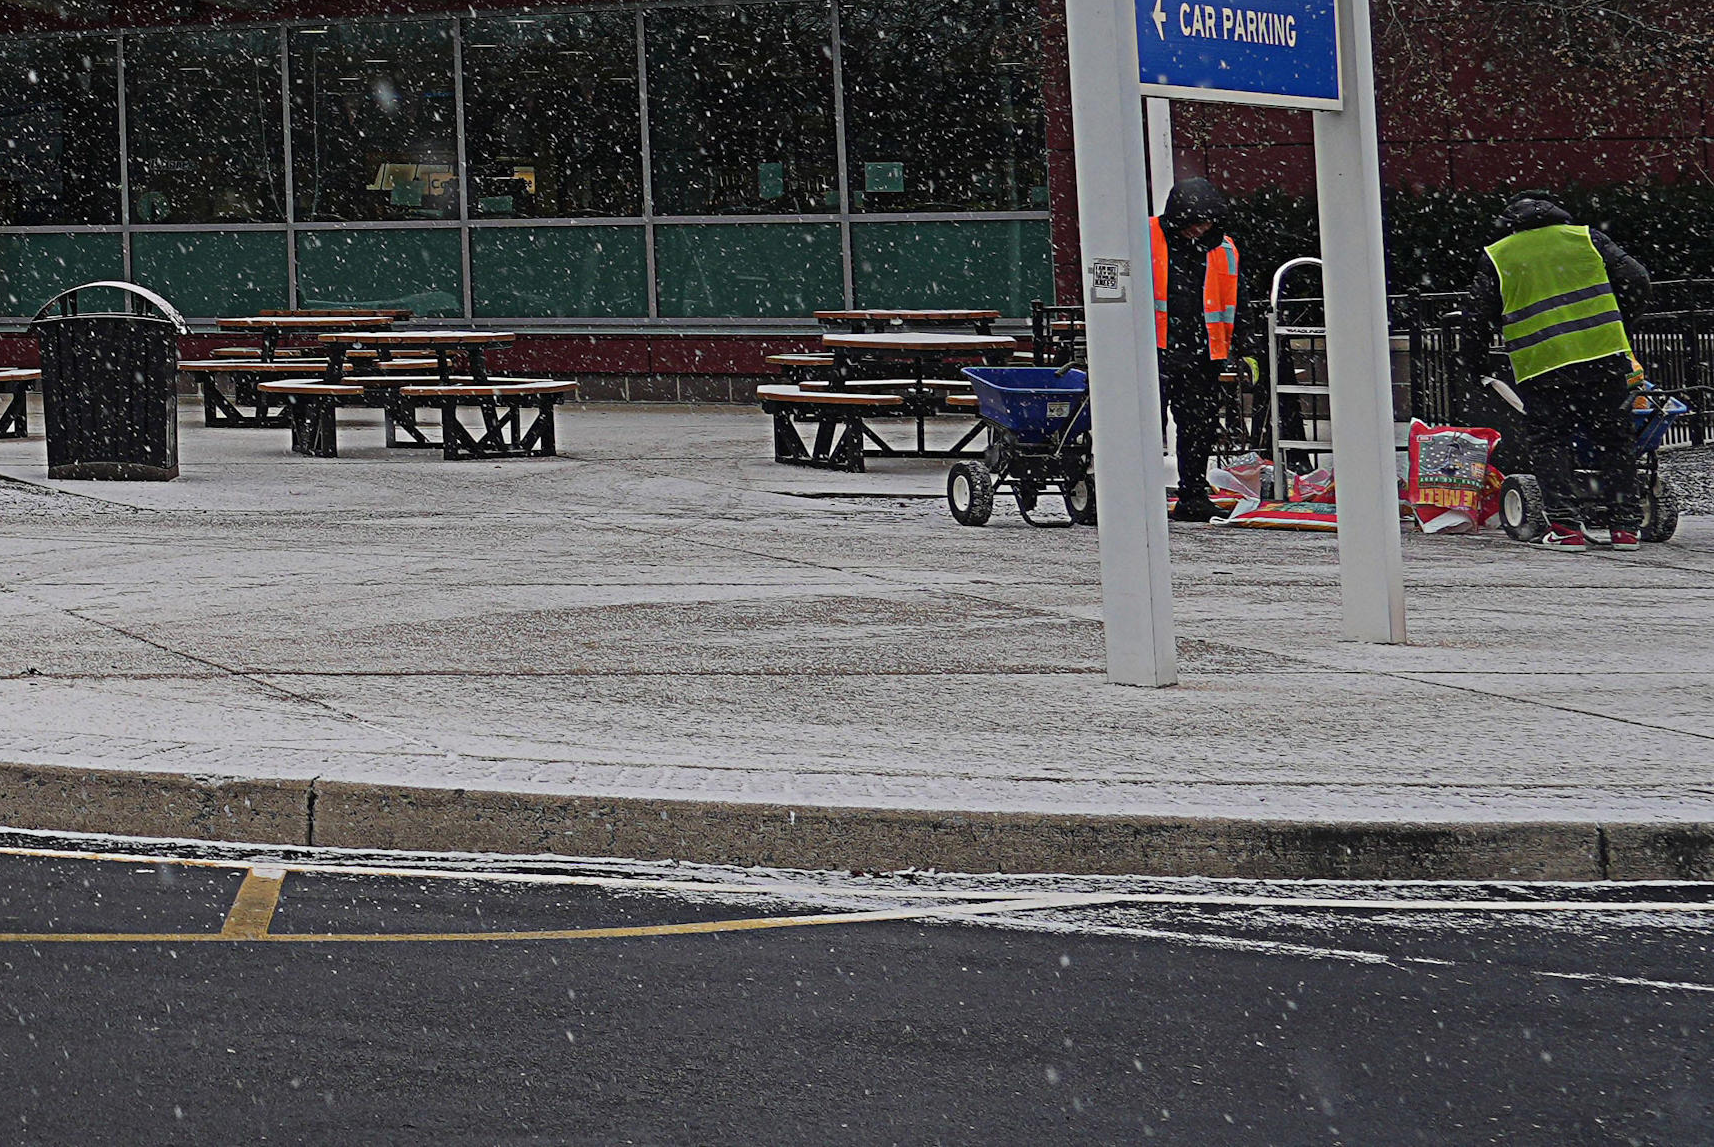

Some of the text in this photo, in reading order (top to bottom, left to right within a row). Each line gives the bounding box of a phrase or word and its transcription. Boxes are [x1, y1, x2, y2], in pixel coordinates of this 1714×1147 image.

[1179, 2, 1297, 48] CAR PARKING
[1416, 488, 1461, 508] MELT
